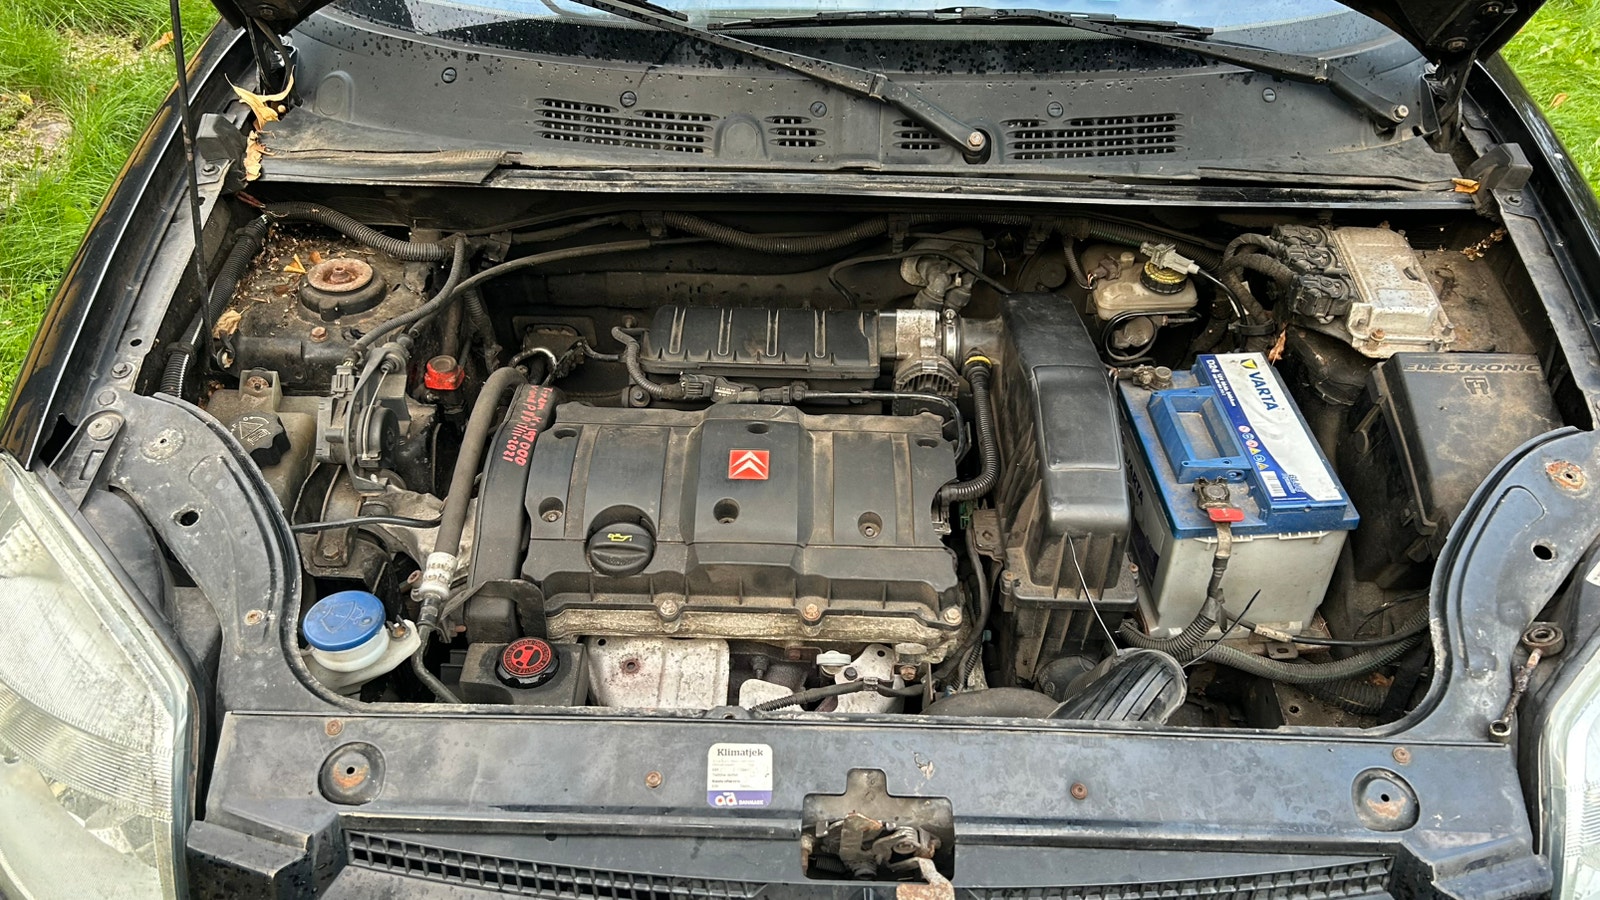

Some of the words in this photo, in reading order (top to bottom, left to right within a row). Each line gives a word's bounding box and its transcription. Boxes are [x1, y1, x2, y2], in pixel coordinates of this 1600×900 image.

[1206, 359, 1220, 373] D24
[1403, 362, 1542, 373] ELECTRONIC
[1247, 371, 1279, 411] VARTA
[717, 748, 764, 758] Klimatjek
